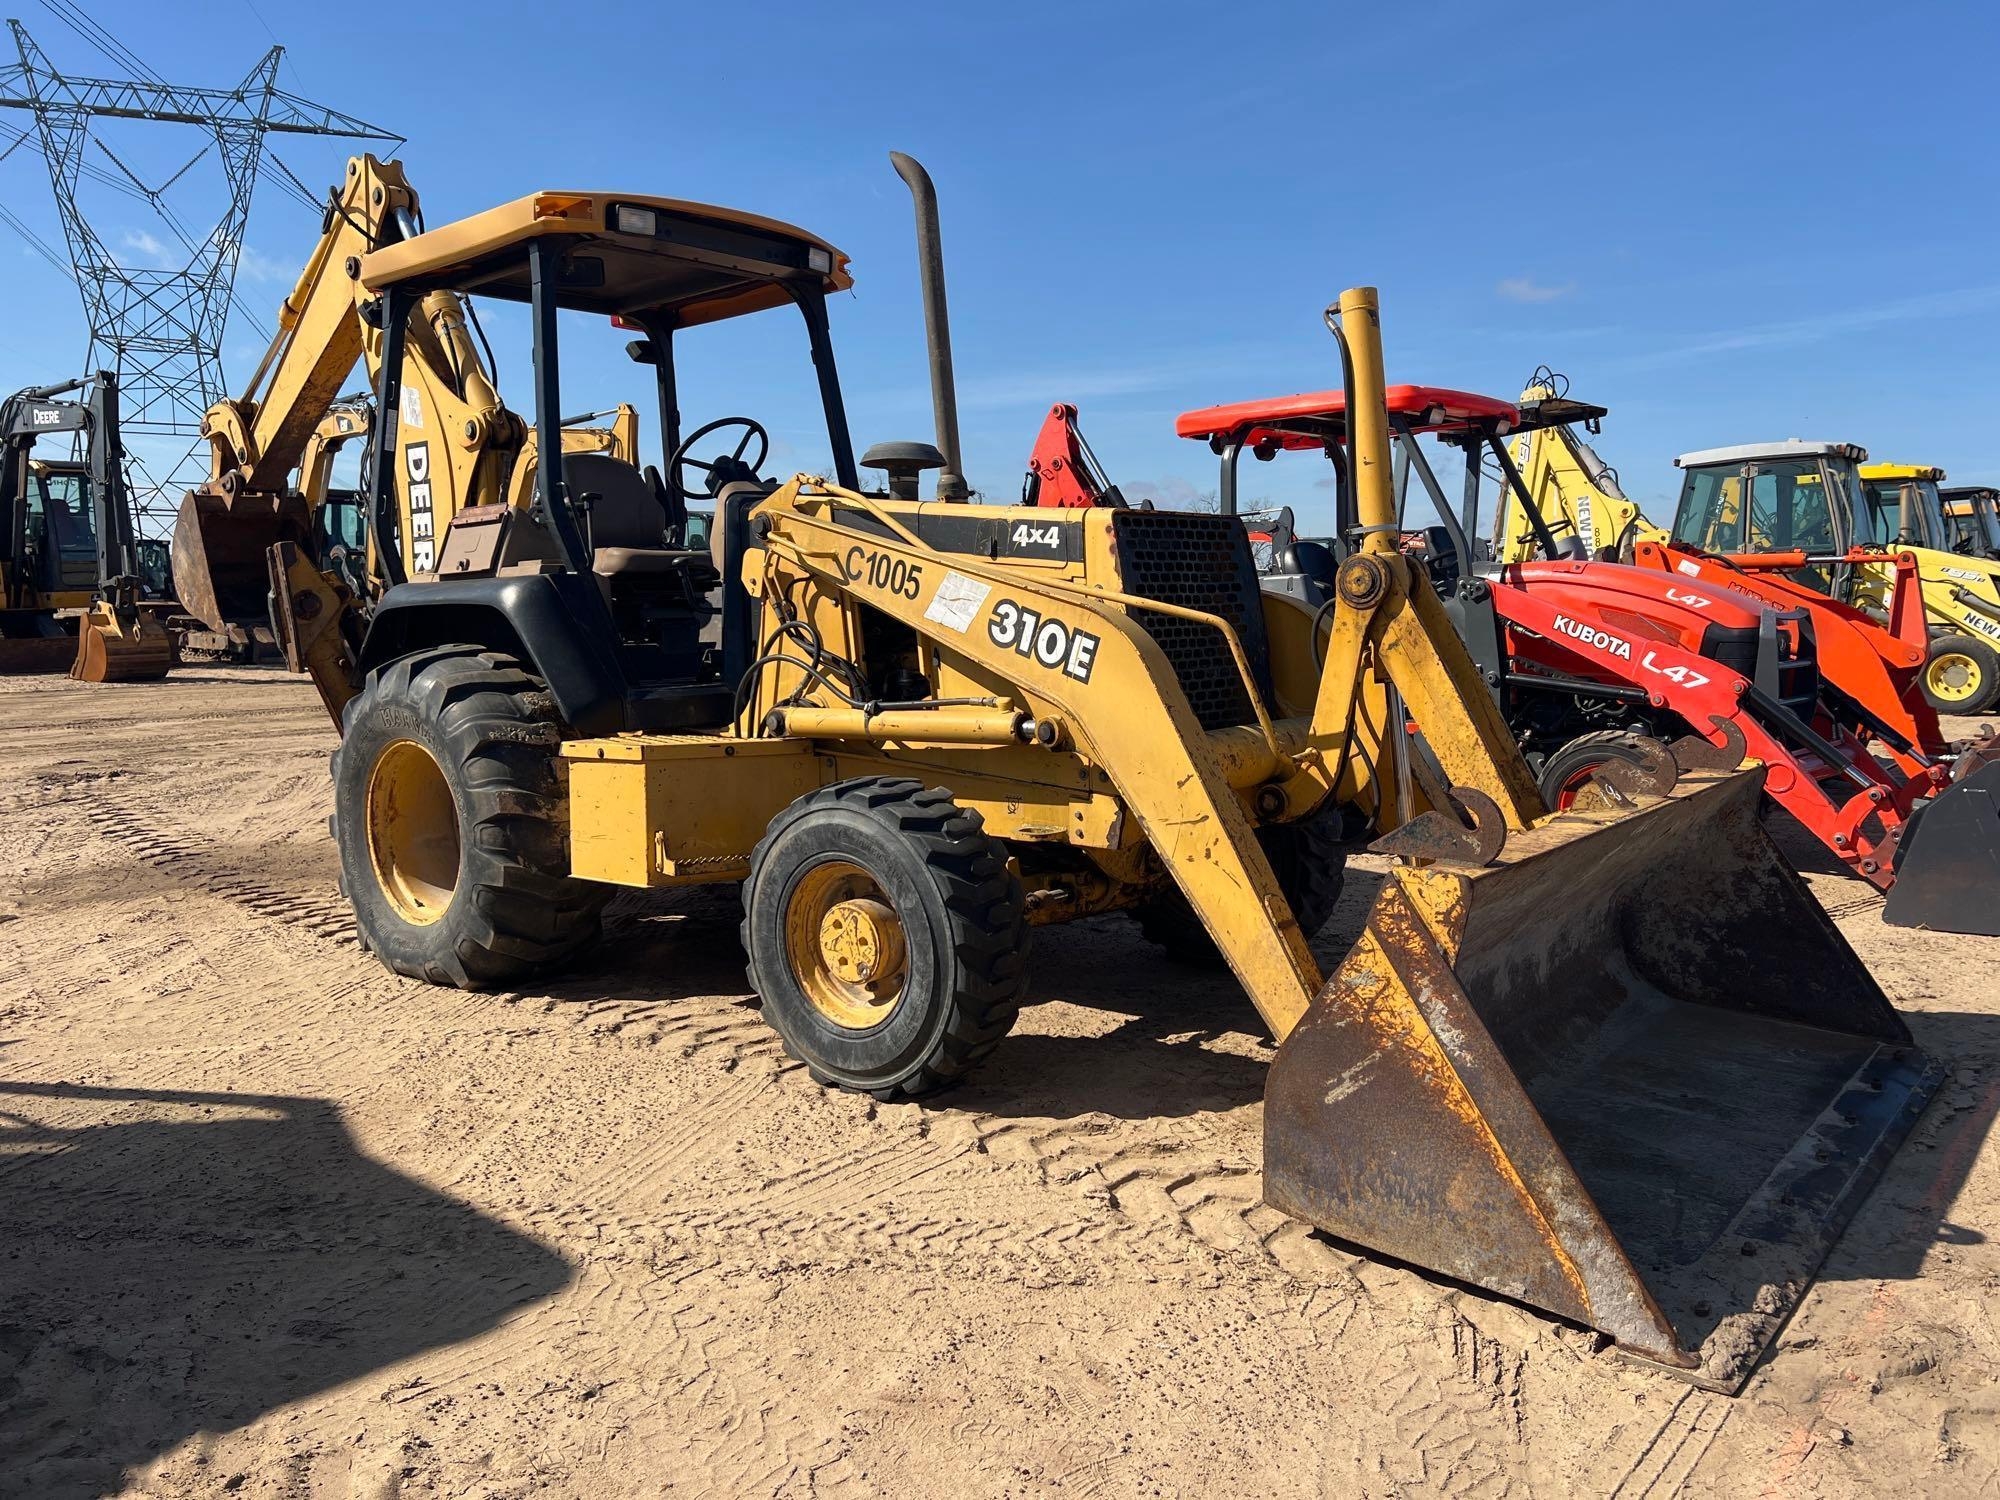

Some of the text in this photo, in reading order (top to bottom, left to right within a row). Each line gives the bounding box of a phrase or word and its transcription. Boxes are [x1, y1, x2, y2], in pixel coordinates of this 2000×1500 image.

[33, 409, 60, 425] DEERE
[405, 440, 435, 574] DEER
[1578, 496, 1592, 532] NEW
[1012, 525, 1060, 549] 4x4
[845, 546, 923, 600] C1005
[1665, 588, 1712, 608] L47
[1963, 612, 1998, 635] NEW
[988, 599, 1101, 685] 310E
[1552, 614, 1711, 688] KUBOTA L47
